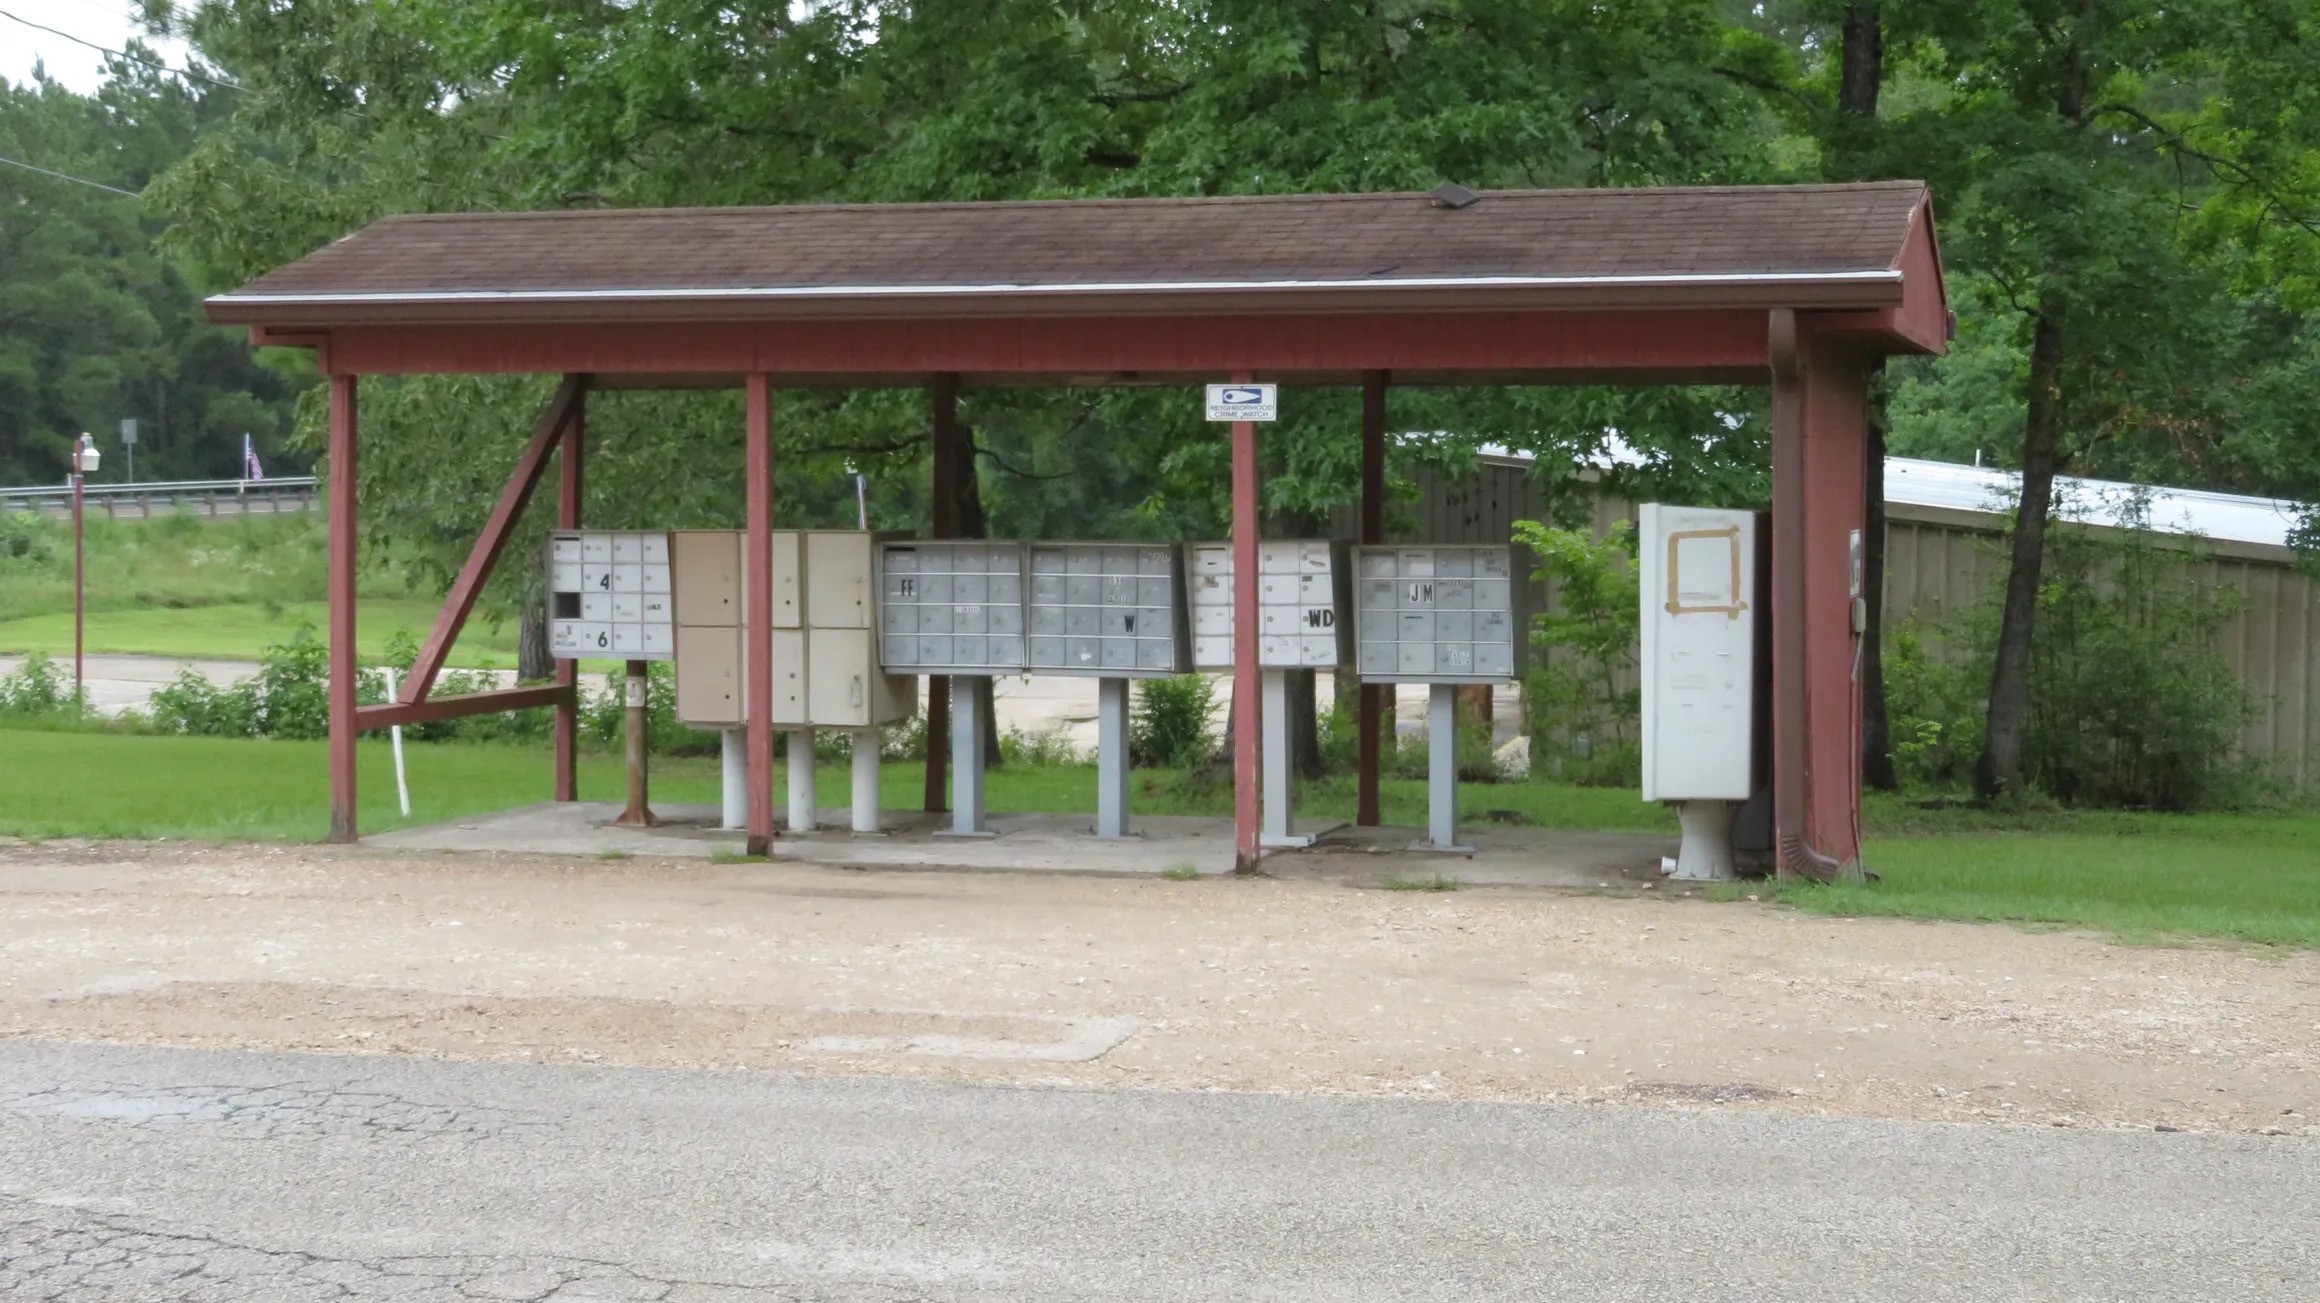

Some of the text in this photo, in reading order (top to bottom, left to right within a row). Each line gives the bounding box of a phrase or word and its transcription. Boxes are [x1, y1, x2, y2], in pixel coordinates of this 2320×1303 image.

[600, 573, 610, 590] 4
[1124, 615, 1135, 632] W
[1308, 609, 1335, 628] WD
[598, 631, 608, 648] 6
